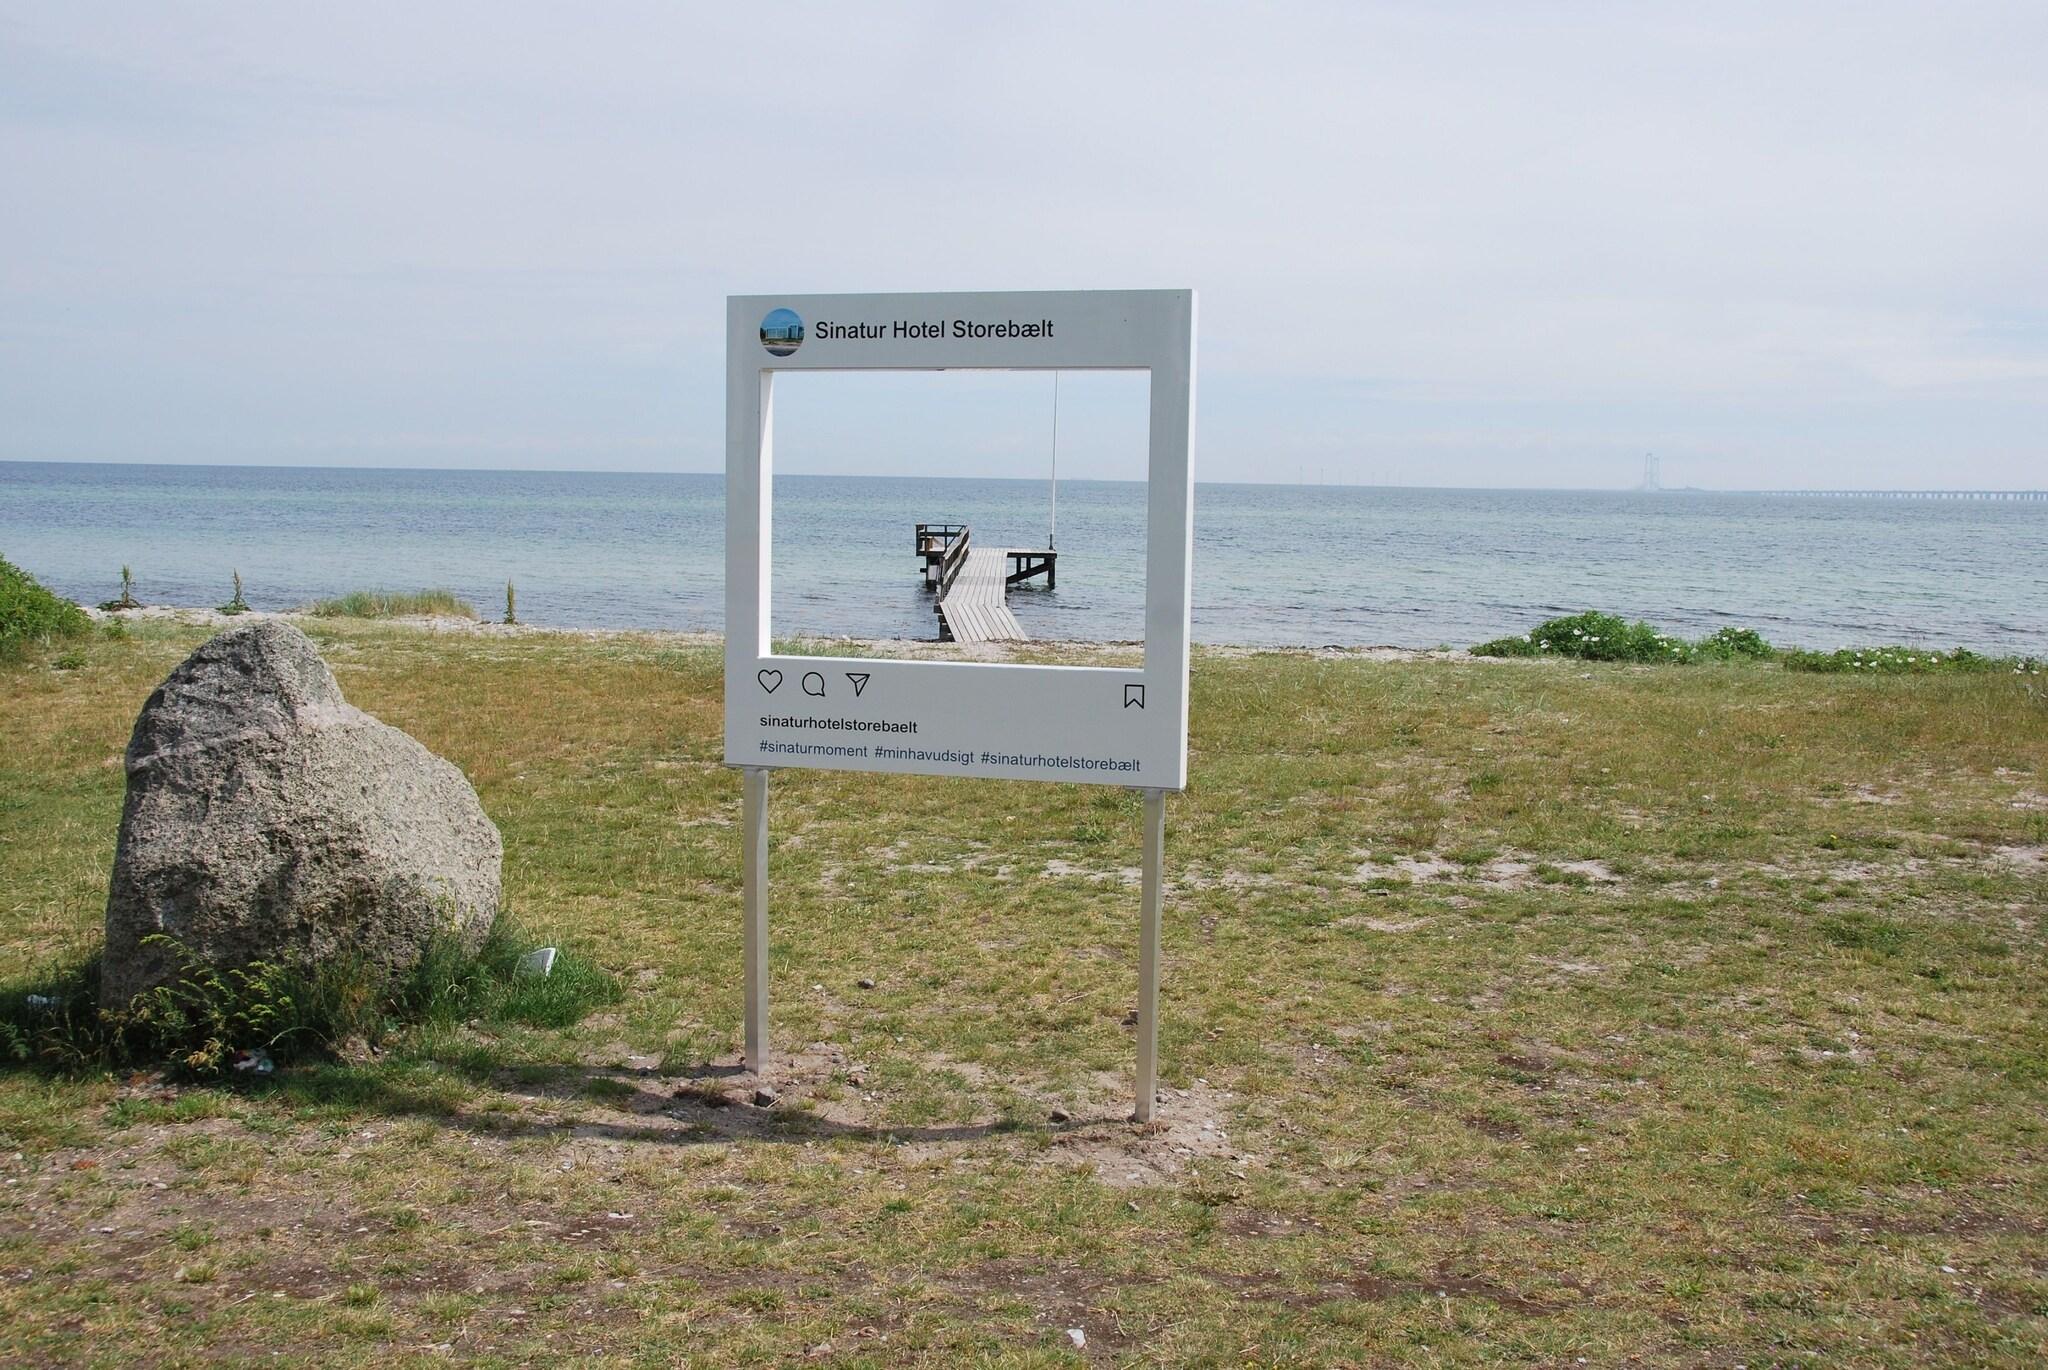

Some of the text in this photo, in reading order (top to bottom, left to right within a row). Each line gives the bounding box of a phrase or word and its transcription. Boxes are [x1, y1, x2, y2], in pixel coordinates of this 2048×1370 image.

[815, 319, 1054, 339] Sinatur Hotel Storebælt
[759, 715, 918, 733] sinaturhotelstorebaelt
[759, 740, 1141, 772] #sinaturmoment #minhavudsigt #sinaturhotelstorebælt
